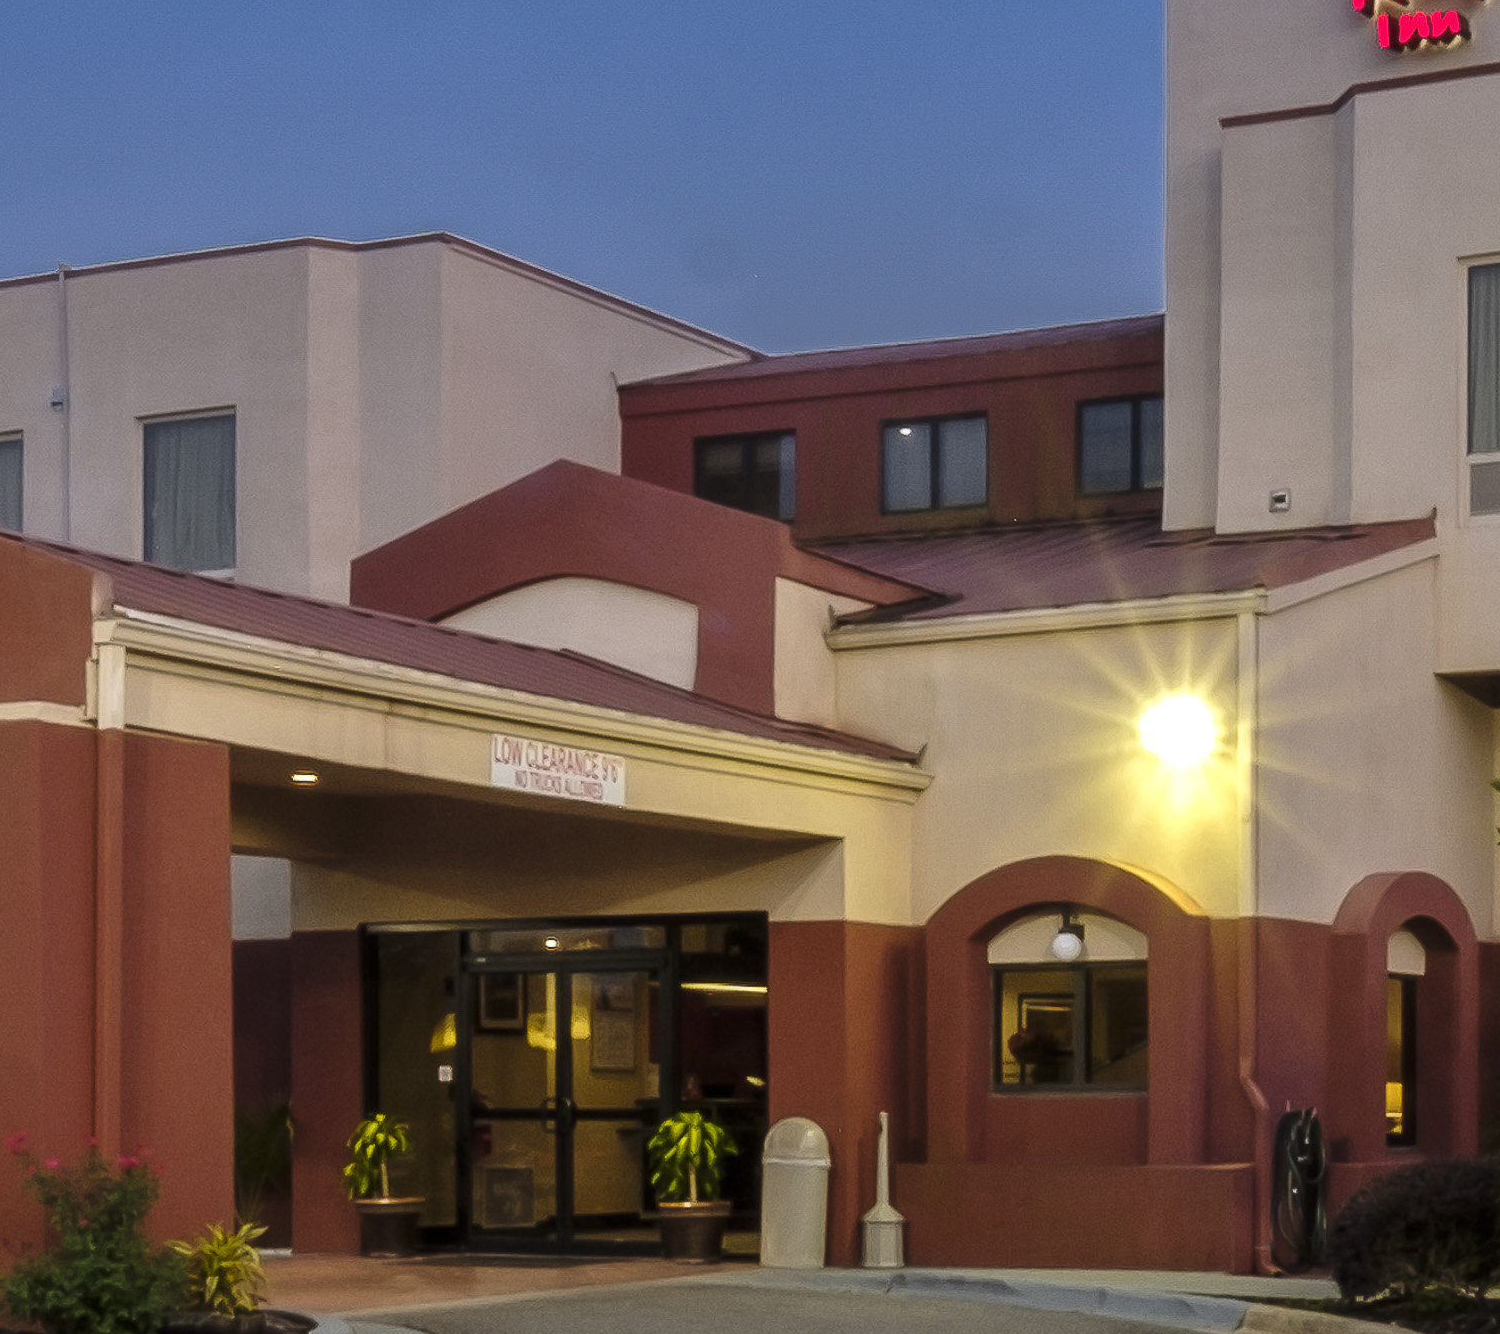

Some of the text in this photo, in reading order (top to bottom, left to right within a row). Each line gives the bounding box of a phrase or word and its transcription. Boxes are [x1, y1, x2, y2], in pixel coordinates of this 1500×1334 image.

[1377, 10, 1461, 48] Inn
[494, 736, 521, 766] LOW
[525, 740, 599, 780] CLEARANCE
